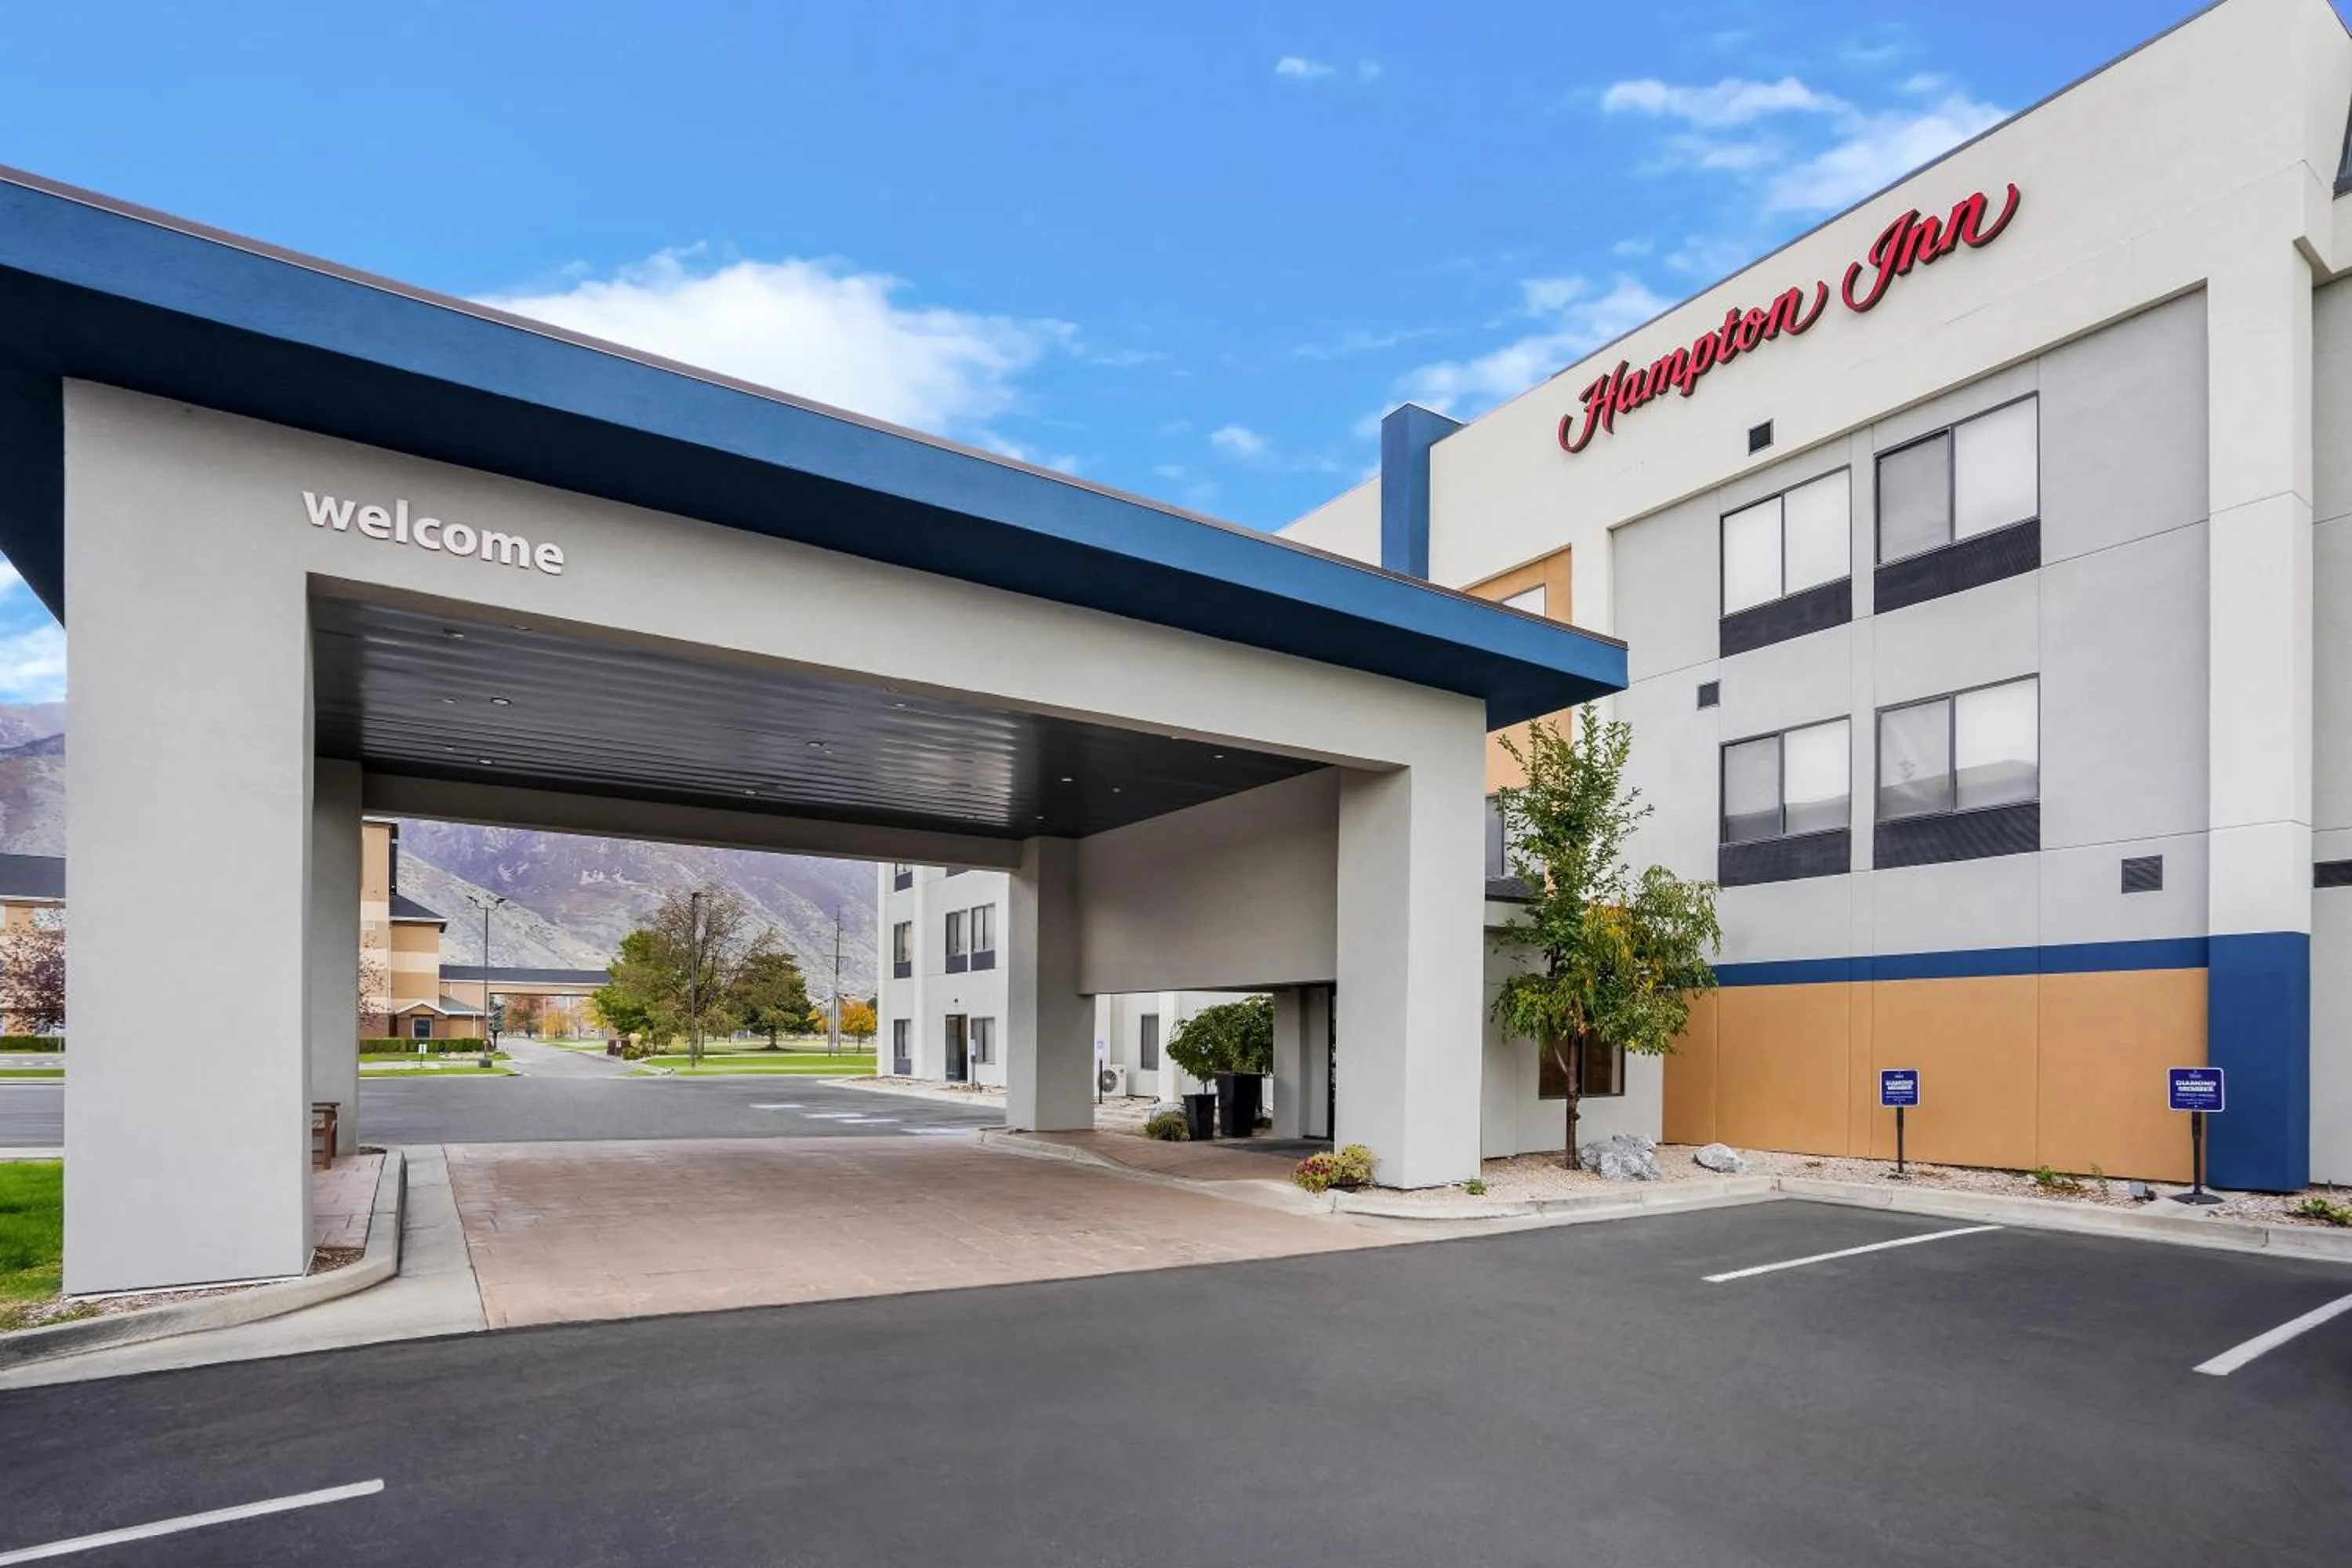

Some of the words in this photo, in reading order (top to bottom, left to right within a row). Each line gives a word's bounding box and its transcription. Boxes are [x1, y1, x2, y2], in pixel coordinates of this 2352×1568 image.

[1557, 280, 1829, 453] Hampton
[1841, 183, 2020, 313] Inn
[301, 490, 565, 575] welcome
